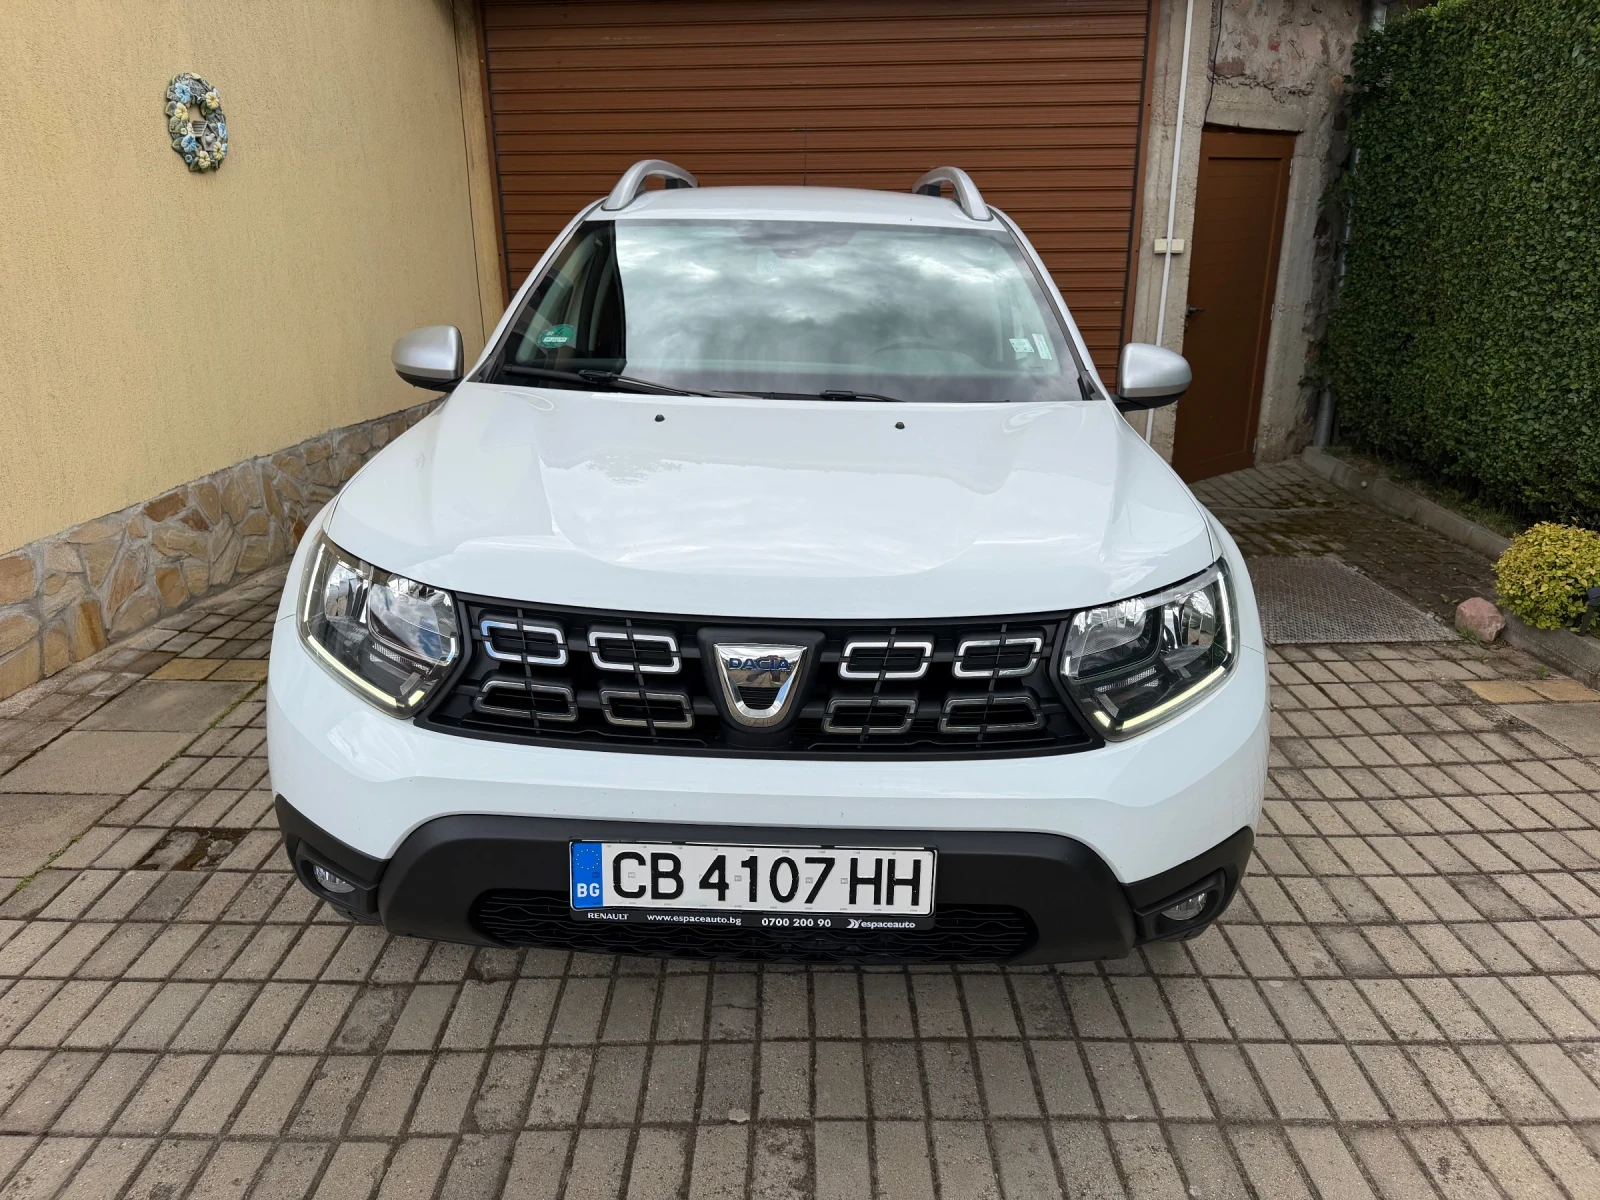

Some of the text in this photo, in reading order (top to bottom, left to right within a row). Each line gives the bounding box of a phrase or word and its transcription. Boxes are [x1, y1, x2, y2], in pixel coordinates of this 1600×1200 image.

[729, 658, 791, 671] DACIA
[612, 851, 922, 906] CB 4107 HH
[577, 883, 600, 898] BG
[588, 912, 629, 920] RENAULT
[646, 913, 742, 925] www.espaceauto.bg
[761, 918, 832, 927] 0700 200 90
[861, 920, 916, 929] espaceauto
